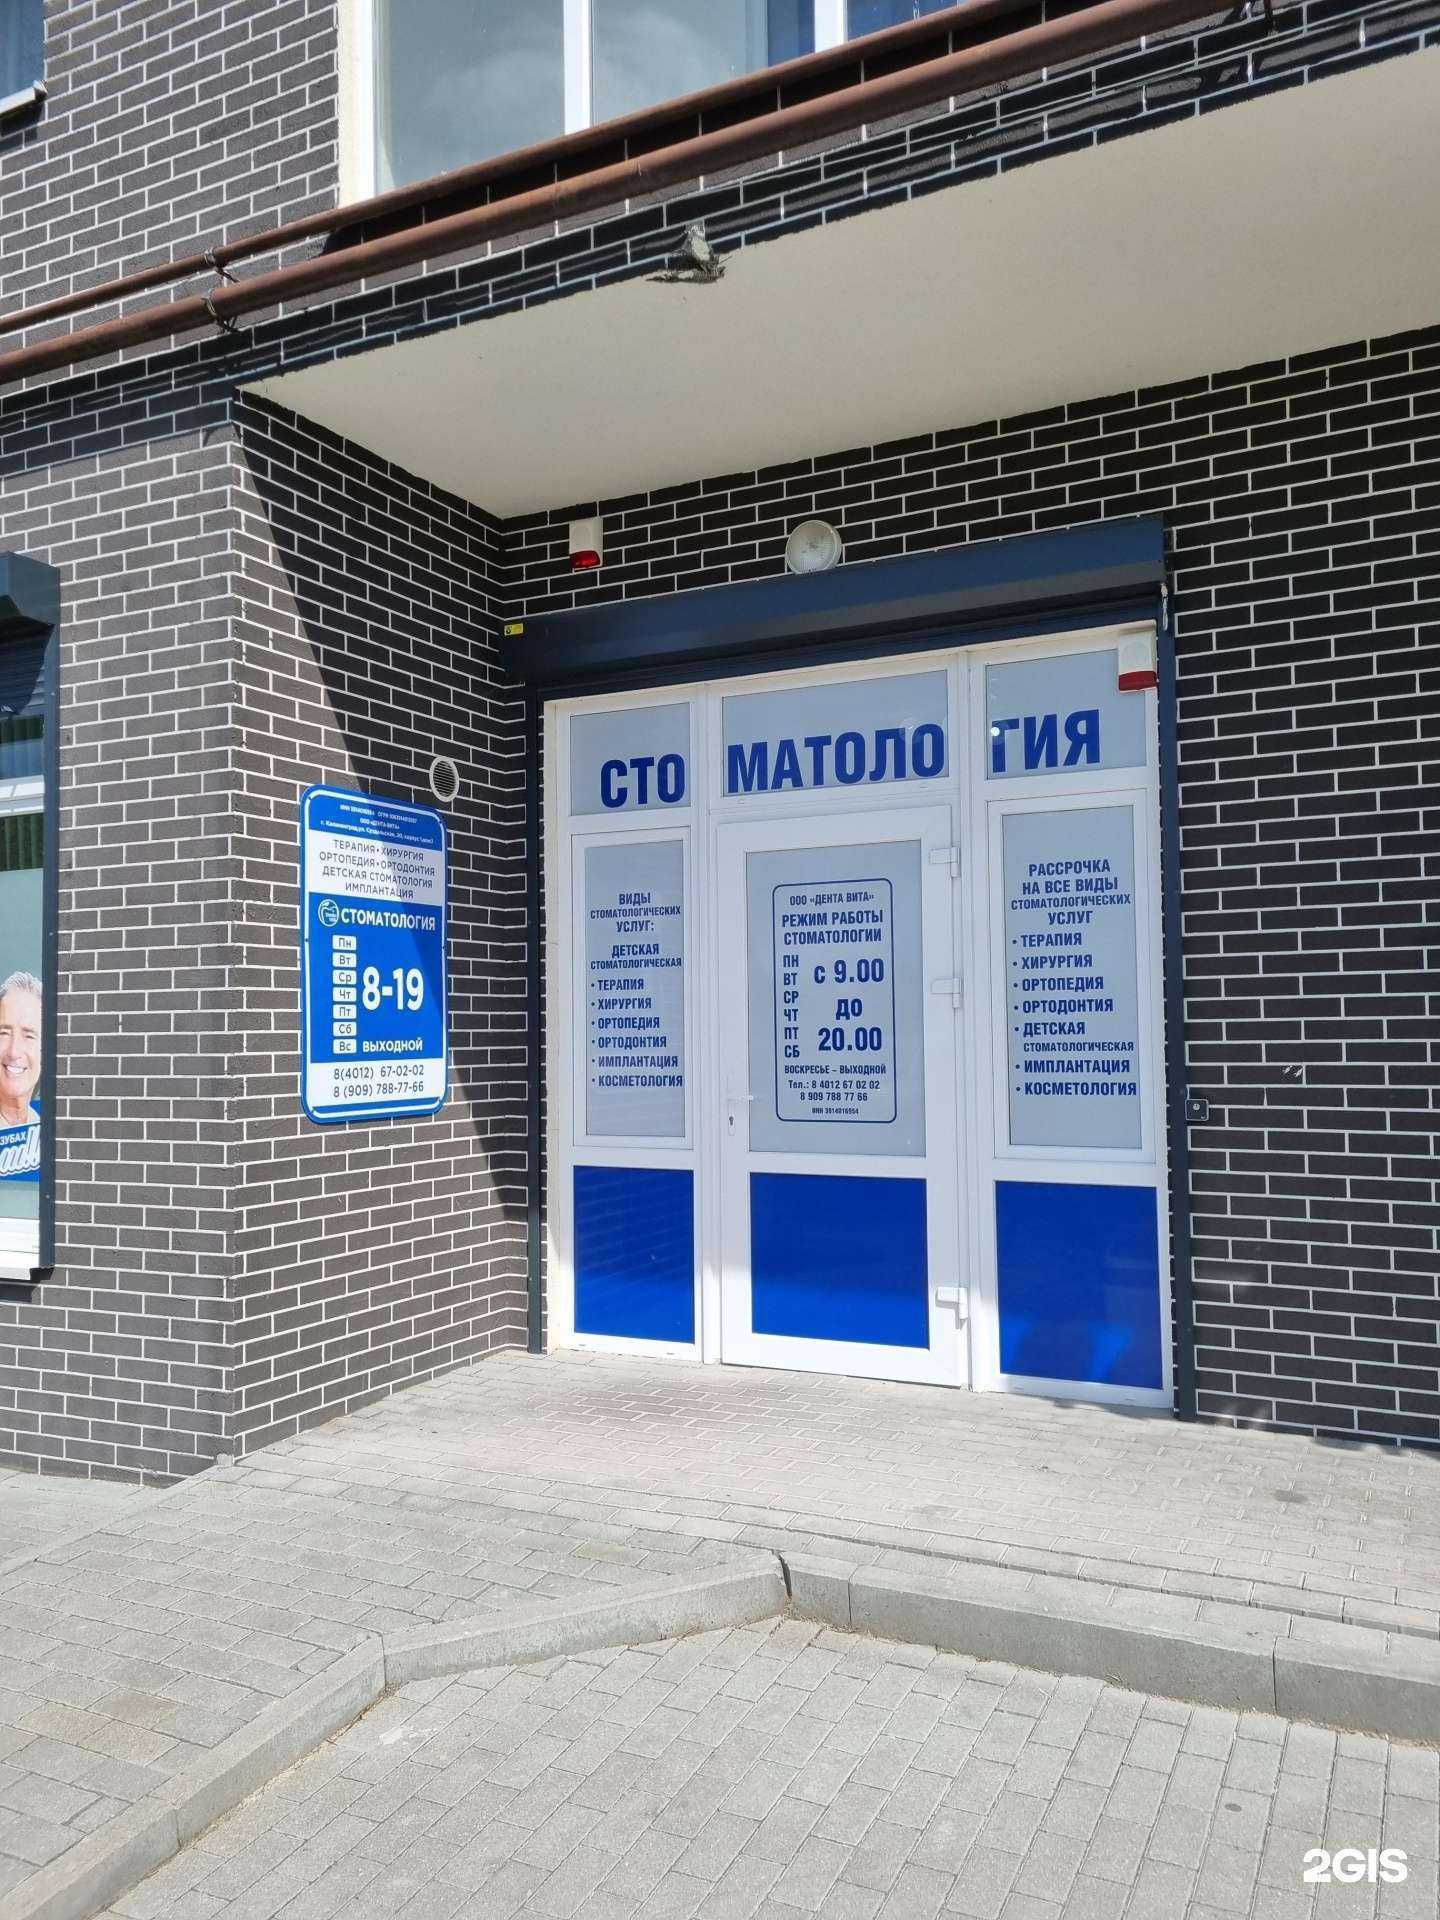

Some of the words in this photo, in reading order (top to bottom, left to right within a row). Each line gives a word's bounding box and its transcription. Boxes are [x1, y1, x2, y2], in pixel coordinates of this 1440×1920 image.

[600, 753, 685, 809] СТО
[727, 723, 944, 794] МАТОЛО
[990, 708, 1100, 774] ГИЯ
[334, 839, 376, 854] ТЕРАПИЯ
[381, 846, 424, 862] ХИРУРГИЯ
[320, 852, 375, 866] ОРТОПЕДИЯ
[380, 860, 434, 876] ОРТОДОНТИЯ
[1028, 860, 1111, 876] РАССРОЧКА
[322, 866, 366, 879] ДЕТСКАЯ
[370, 872, 432, 888] СТОМАТОЛОГИЯ
[345, 882, 414, 899] ИМПЛАНТАЦИЯ
[1022, 882, 1040, 895] НА
[1044, 880, 1071, 894] ВСЕ
[1076, 877, 1118, 893] ВИДЫ
[618, 892, 650, 906] ВИДЫ
[790, 895, 807, 906] ООО
[809, 892, 844, 906] «ДЕНТА
[846, 891, 874, 903] ВИТА»
[1011, 894, 1131, 910] СТОМАТОЛОГИЧЕСКИХ
[341, 908, 436, 930] СТОМАТОЛОГИЯ
[590, 906, 681, 919] СТОМАТОЛОГИЧЕСКИХ
[782, 912, 828, 928] РЕЖИМ
[832, 909, 883, 924] РАБОТЫ
[1048, 910, 1094, 926] УСЛУГ
[616, 920, 654, 933] УСЛУГ:
[339, 938, 352, 948] Пн
[784, 928, 882, 945] СТОМАТОЛОГИИ
[1021, 932, 1082, 948] ТЕРАПИЯ
[612, 944, 659, 958] ДЕТСКАЯ
[339, 956, 351, 965] Вт
[590, 957, 682, 970] СТОМАТОЛОГИЧЕСКАЯ
[783, 954, 799, 968] ПН
[1021, 954, 1093, 970] ХИРУРГИЯ
[833, 958, 884, 983] 9.00
[339, 973, 352, 984] Ср
[598, 978, 644, 991] ТЕРАПИЯ
[783, 972, 797, 986] ВТ
[1022, 976, 1104, 992] ОРТОПЕДИЯ
[339, 990, 351, 1000] Чт
[362, 966, 424, 1011] 8-19
[598, 998, 652, 1010] ХИРУРГИЯ
[783, 991, 799, 1004] СР
[339, 1007, 351, 1017] Пт
[835, 998, 863, 1021] до
[1022, 998, 1114, 1014] ОРТОДОНТИЯ
[784, 1008, 798, 1022] ЧТ
[339, 1024, 352, 1034] Сб
[598, 1017, 660, 1030] ОРТОПЕДИЯ
[1023, 1022, 1086, 1038] ДЕТСКАЯ
[784, 1027, 798, 1040] ПТ
[818, 1026, 882, 1051] 20.00
[339, 1042, 352, 1051] Вс
[362, 1037, 423, 1053] ВЫХОДНОЙ
[598, 1036, 667, 1050] ОРТОДОНТИЯ
[1024, 1042, 1134, 1052] СТОМАТОЛОГИЧЕСКАЯ
[784, 1045, 800, 1058] СБ
[599, 1056, 678, 1069] ИМПЛАНТАЦИЯ
[784, 1065, 830, 1074] ВОСКРЕСЬЕ
[840, 1063, 886, 1075] ВЫХОДНОЙ
[1024, 1060, 1130, 1075] ИМПЛАНТАЦИЯ
[334, 1066, 374, 1081] 8(4012)
[380, 1064, 424, 1077] 67-02-02
[599, 1075, 683, 1087] КОСМЕТОЛОГИЯ
[788, 1080, 809, 1089] Тел.:
[812, 1080, 817, 1089] 8
[820, 1080, 840, 1089] 4012
[842, 1080, 853, 1089] 67
[856, 1080, 866, 1089] 02
[869, 1080, 880, 1089] 02
[334, 1086, 340, 1098] 8
[344, 1084, 372, 1098] (909)
[376, 1081, 424, 1095] 788-77-66
[1024, 1082, 1137, 1096] КОСМЕТОЛОГИЯ
[800, 1092, 805, 1101] 8
[808, 1092, 823, 1101] 909
[826, 1092, 841, 1101] 788
[844, 1092, 854, 1101] 77
[857, 1092, 868, 1101] 66
